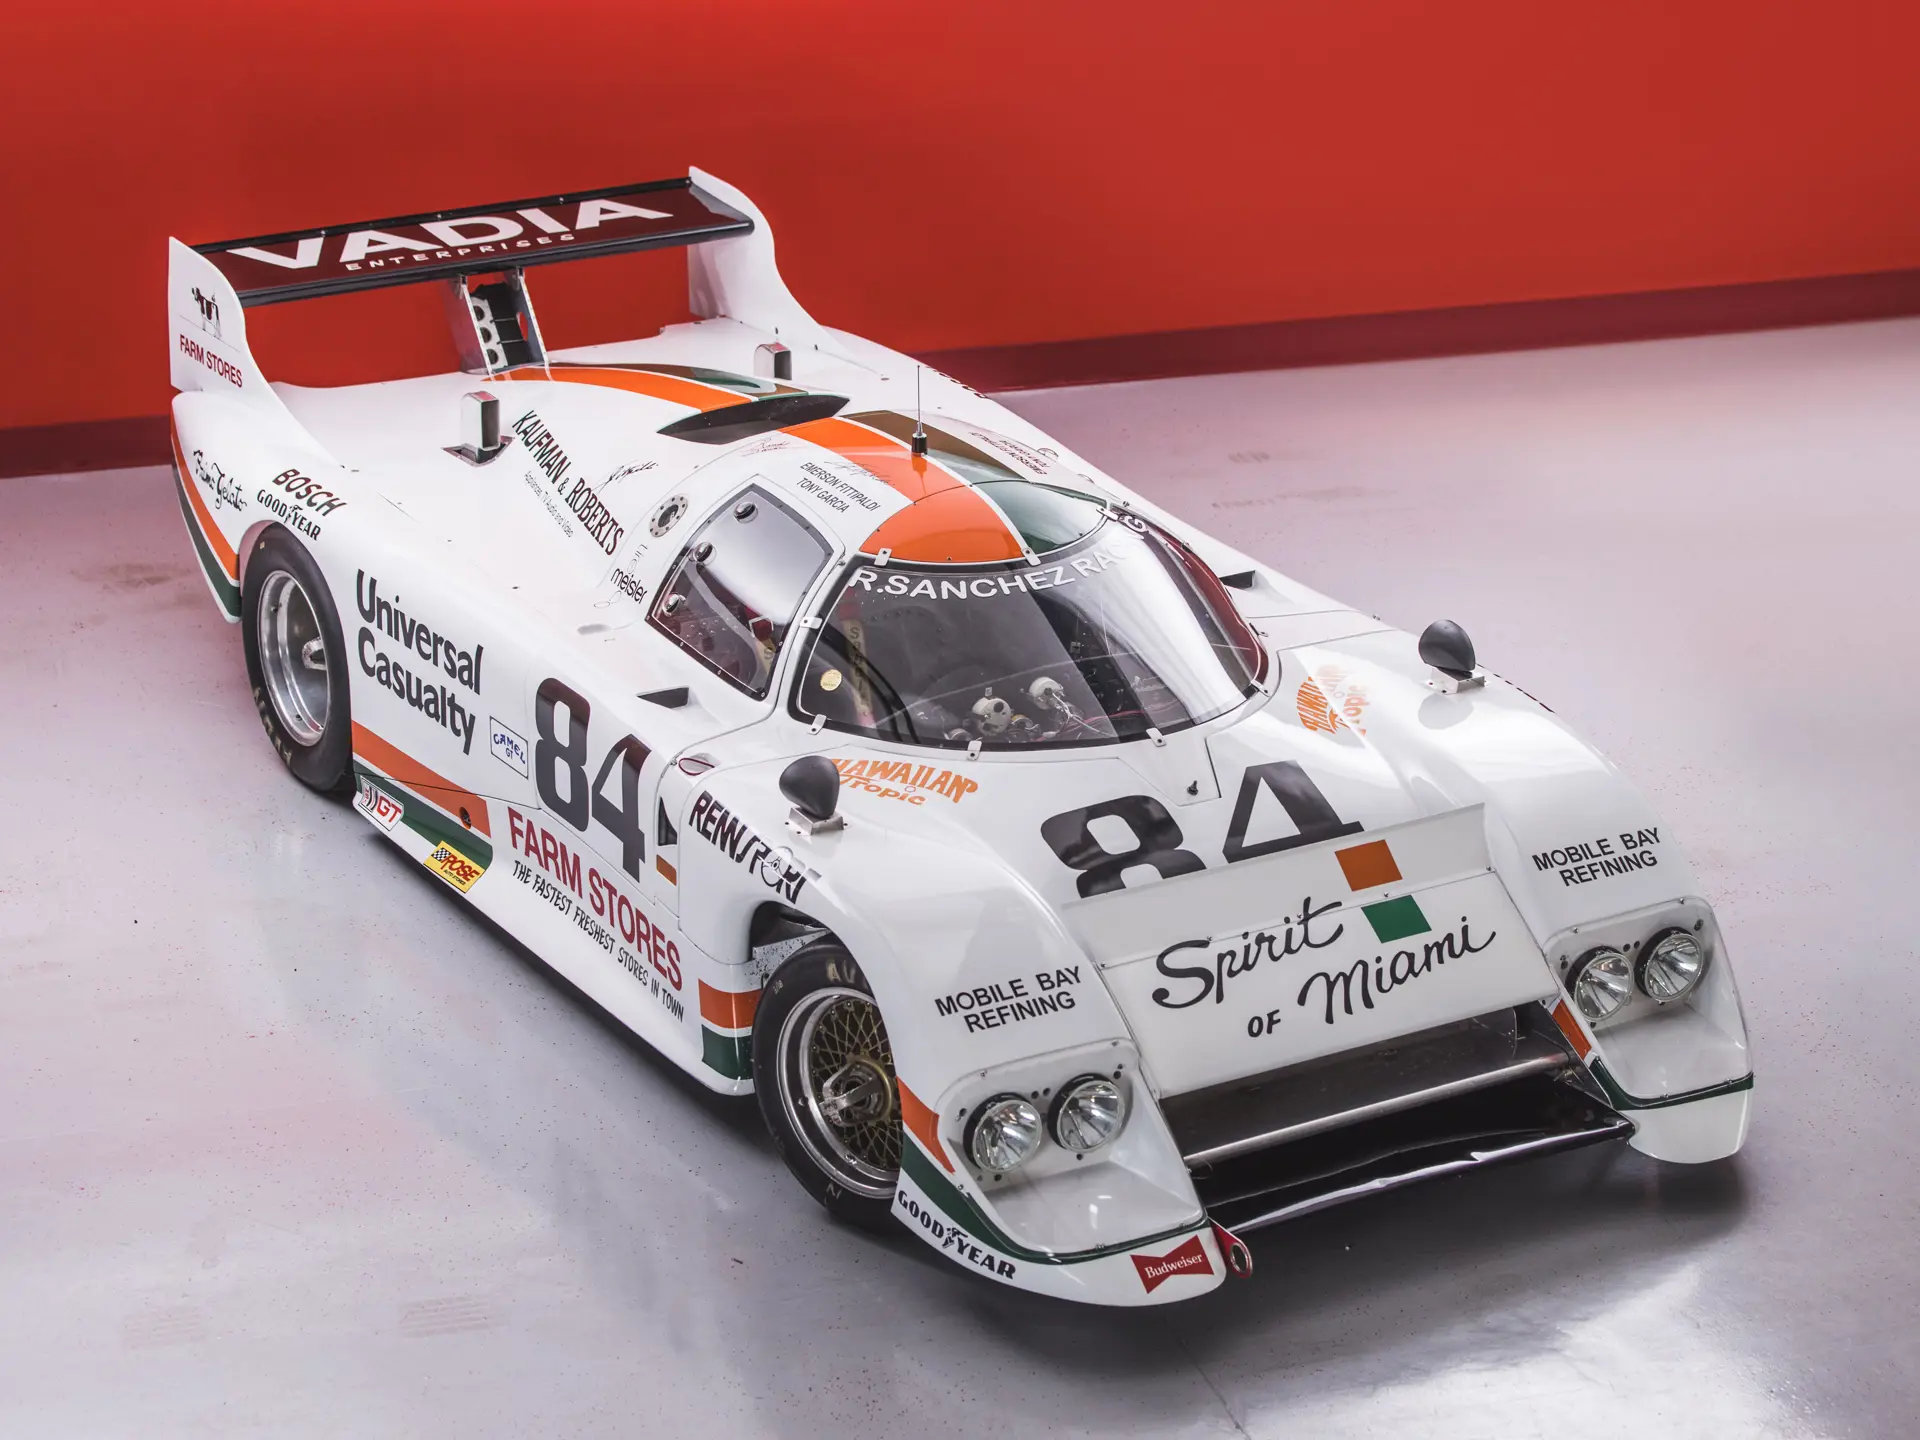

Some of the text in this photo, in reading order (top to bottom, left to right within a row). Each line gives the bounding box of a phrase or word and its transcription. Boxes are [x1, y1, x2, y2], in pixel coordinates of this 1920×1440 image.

[225, 199, 674, 271] VADIA
[345, 233, 576, 271] ENTERPRISES
[179, 334, 243, 388] FARM STORES
[272, 468, 347, 517] BOSCH
[511, 410, 572, 484] KAUFMAN
[557, 477, 570, 496] &
[564, 477, 625, 556] ROBERTS
[796, 477, 850, 513] TONY GARCIA
[800, 462, 842, 490] EMERSON
[838, 482, 882, 512] FITTIPALDI
[356, 568, 484, 695] Universal
[357, 626, 476, 755] Casualty
[493, 733, 526, 764] CAMEL
[505, 749, 514, 760] GT
[535, 677, 652, 883] 84
[376, 795, 402, 823] GT
[1040, 760, 1365, 899] 84
[440, 854, 480, 882] ROSE
[1531, 827, 1661, 871] MOBILE BAY
[1558, 850, 1658, 887] REFINING
[507, 806, 683, 991] FARM STORES
[513, 860, 684, 1023] THE FASTEST FRESHEST STORES IN TOWN
[1151, 896, 1344, 1009] Spirit
[934, 965, 1081, 1016] MOBILE BAY
[1247, 916, 1496, 1038] OF Miami
[963, 991, 1076, 1033] REFINING
[1143, 1252, 1203, 1280] Budweiser
